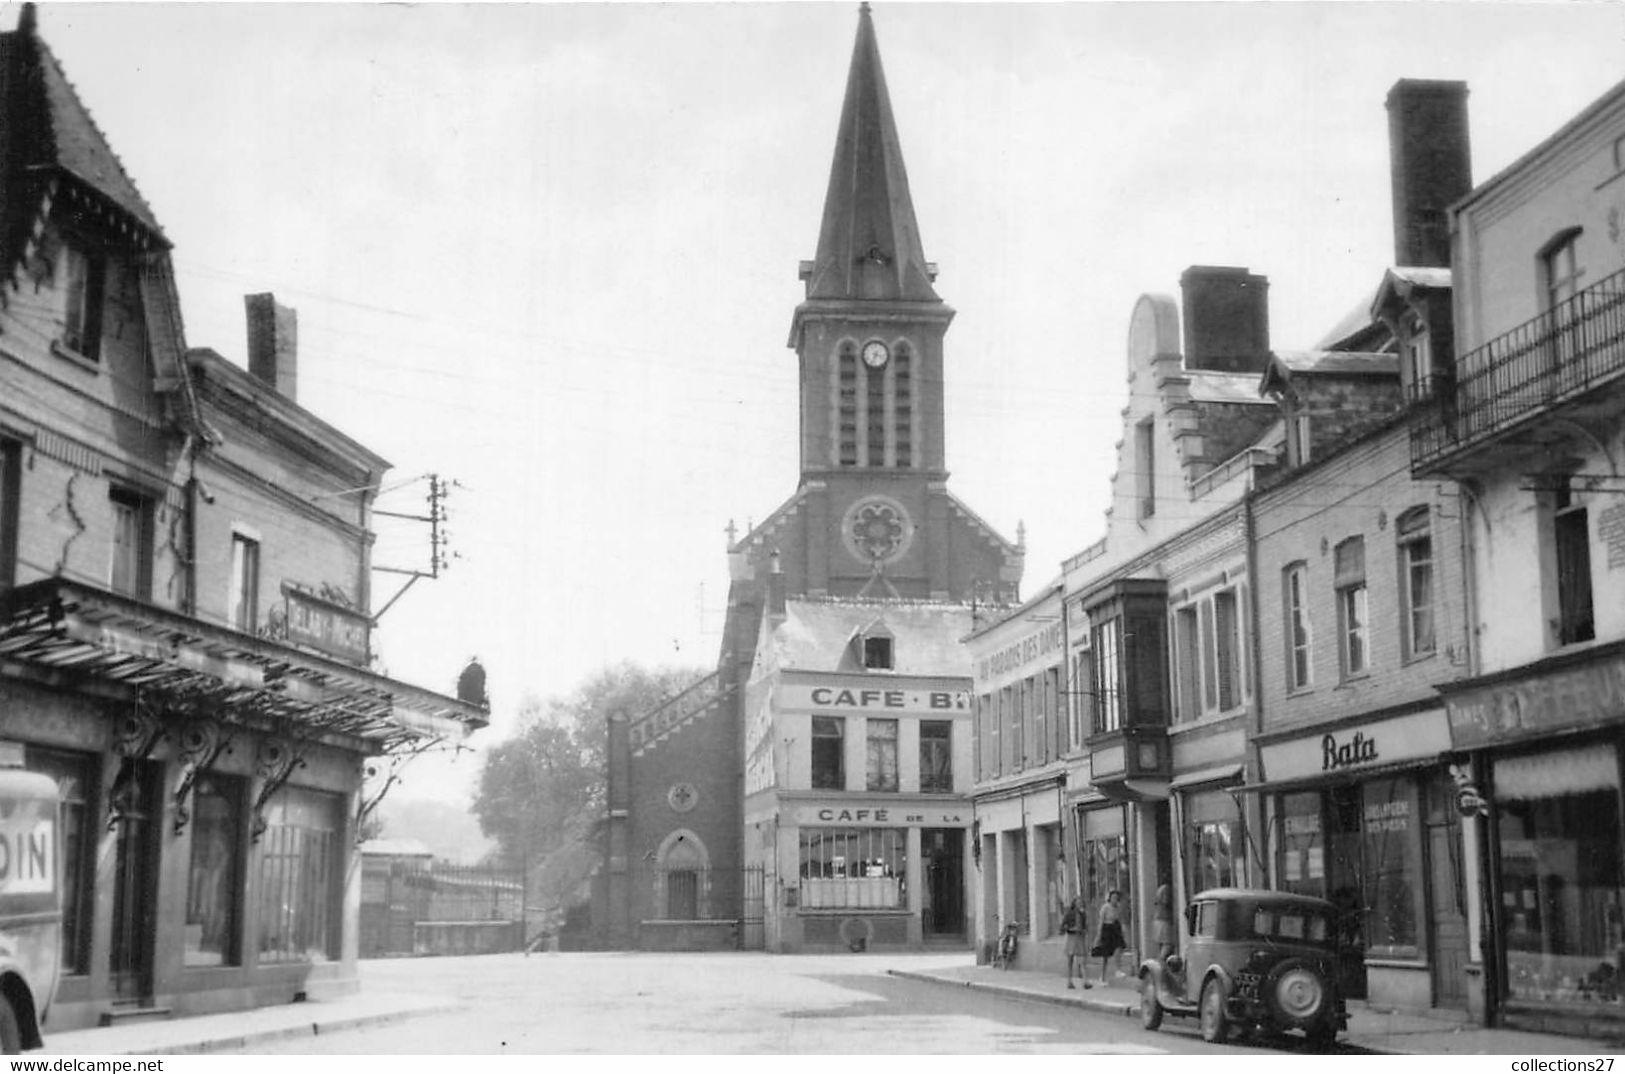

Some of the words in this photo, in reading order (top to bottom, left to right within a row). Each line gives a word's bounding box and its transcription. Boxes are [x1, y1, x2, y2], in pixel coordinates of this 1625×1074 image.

[818, 806, 889, 822] CAFÉ
[906, 814, 925, 823] DE
[942, 814, 961, 823] LA
